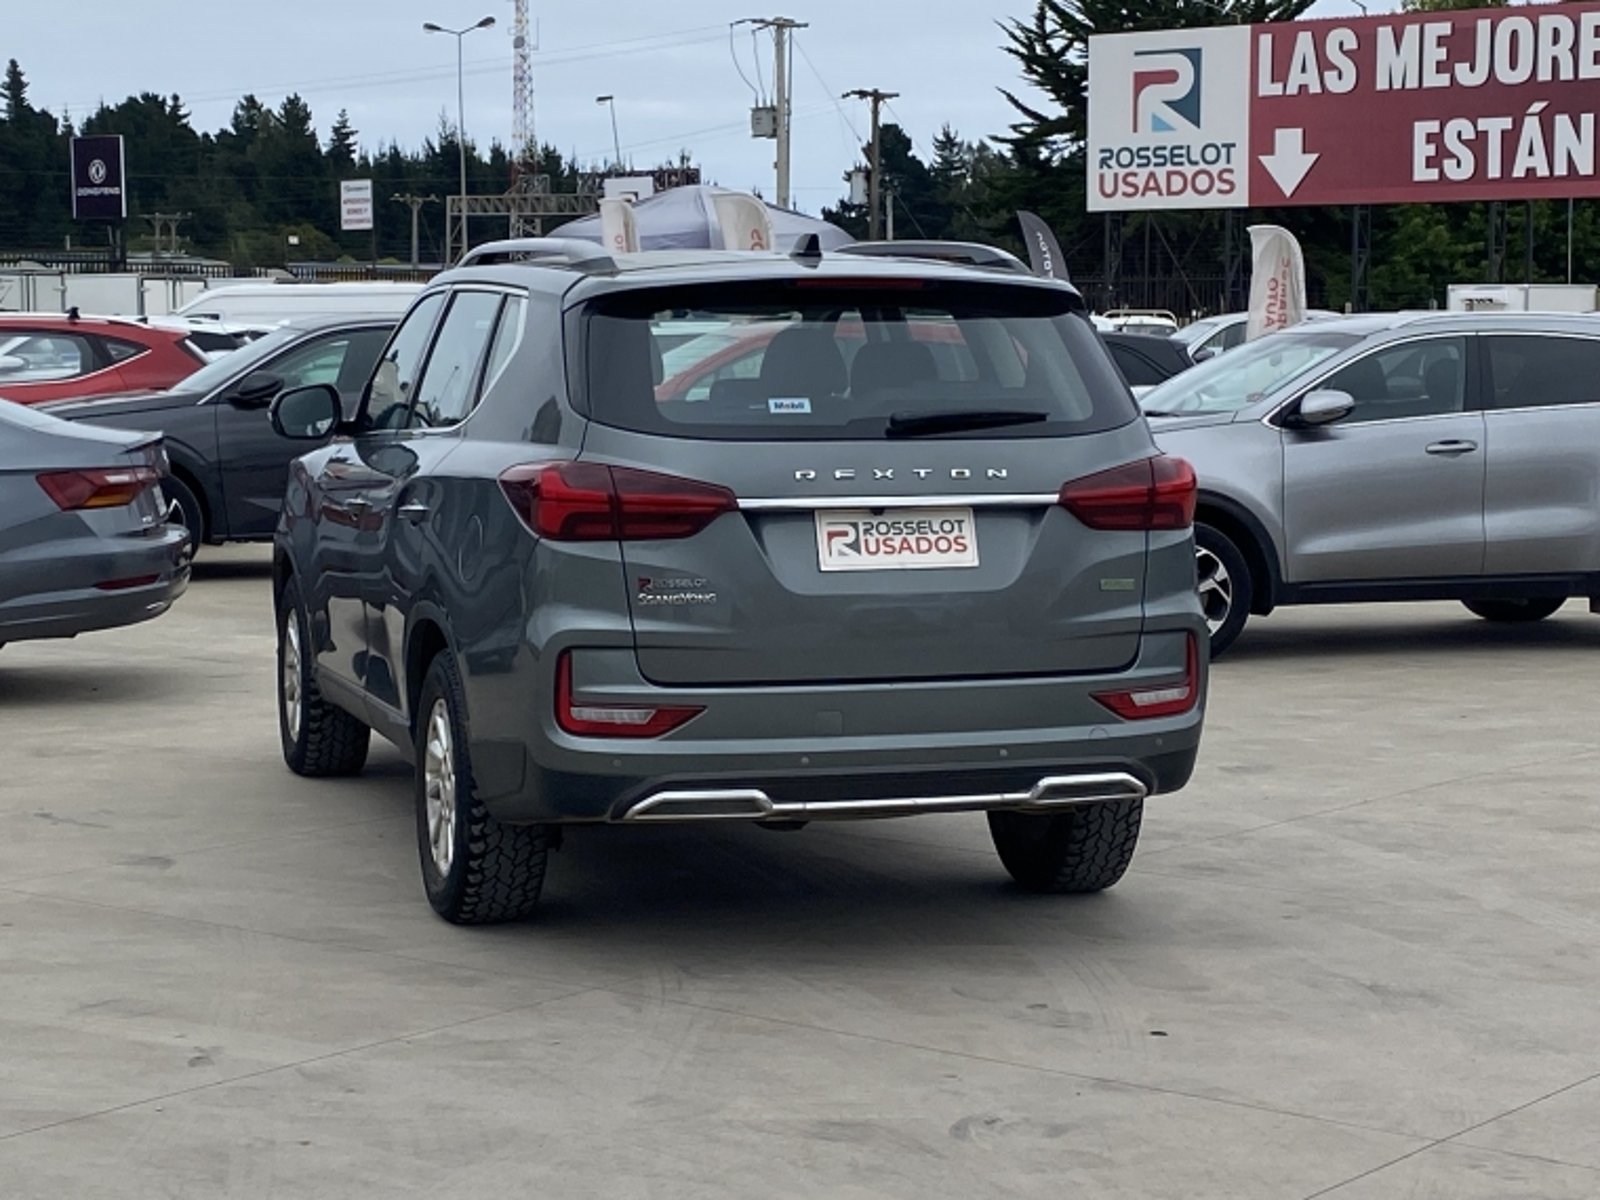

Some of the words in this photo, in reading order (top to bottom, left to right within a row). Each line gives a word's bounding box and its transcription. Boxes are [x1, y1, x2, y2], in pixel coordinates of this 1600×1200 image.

[1258, 27, 1359, 97] LAS
[1412, 101, 1595, 182] ESTÁN
[1098, 142, 1236, 170] ROSSELOT
[1098, 168, 1236, 198] USADOS
[795, 468, 1009, 481] REXTON
[862, 519, 966, 537] ROSSELOT
[864, 535, 968, 556] USADOS
